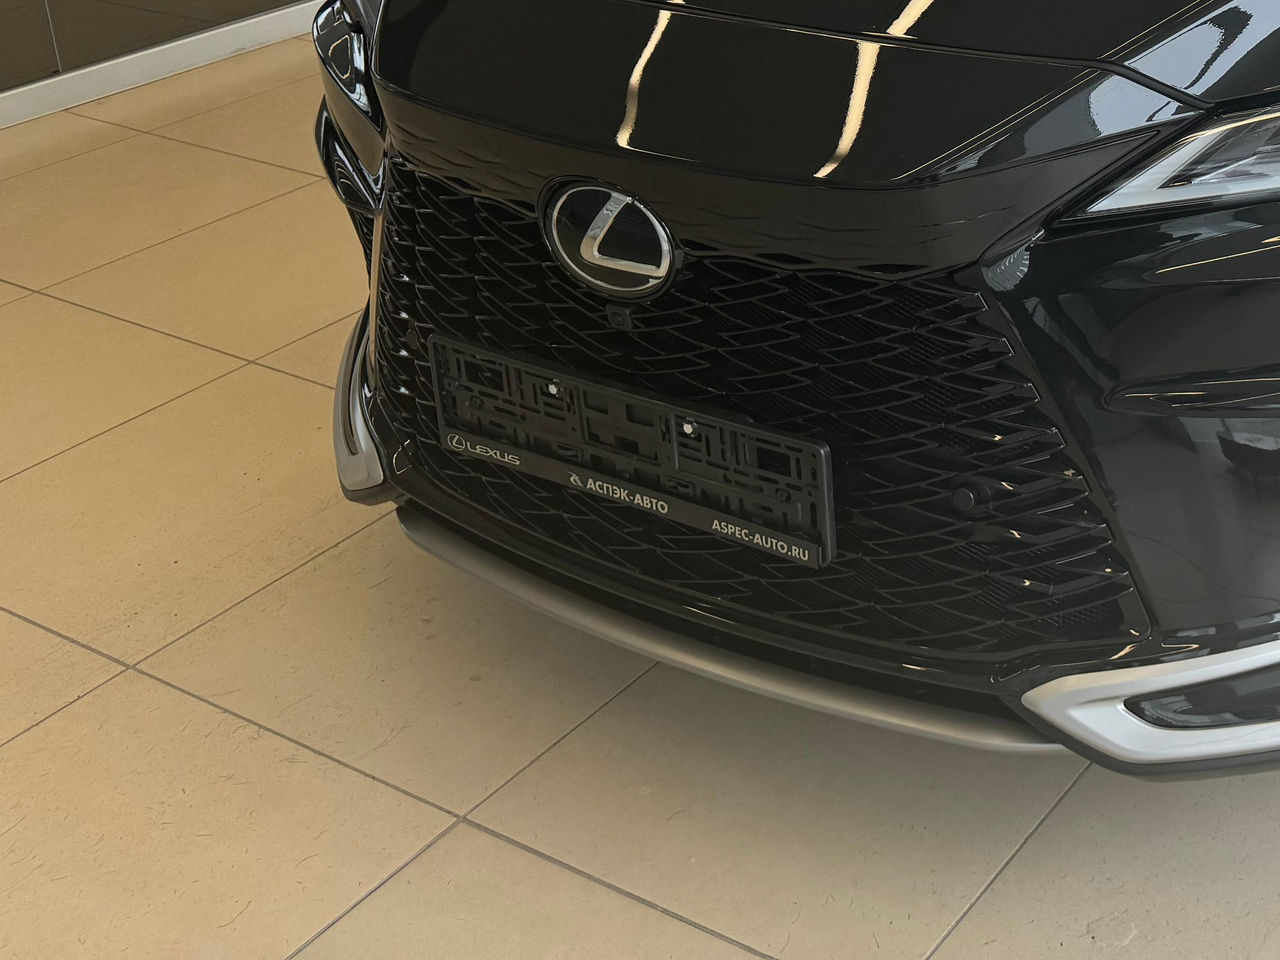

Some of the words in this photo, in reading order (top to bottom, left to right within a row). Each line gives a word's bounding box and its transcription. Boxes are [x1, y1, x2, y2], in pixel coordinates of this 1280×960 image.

[467, 441, 521, 466] LEXUS
[586, 477, 669, 515] АСПЭК-АВТО
[712, 519, 809, 561] ASPEC-AUTO.RU
